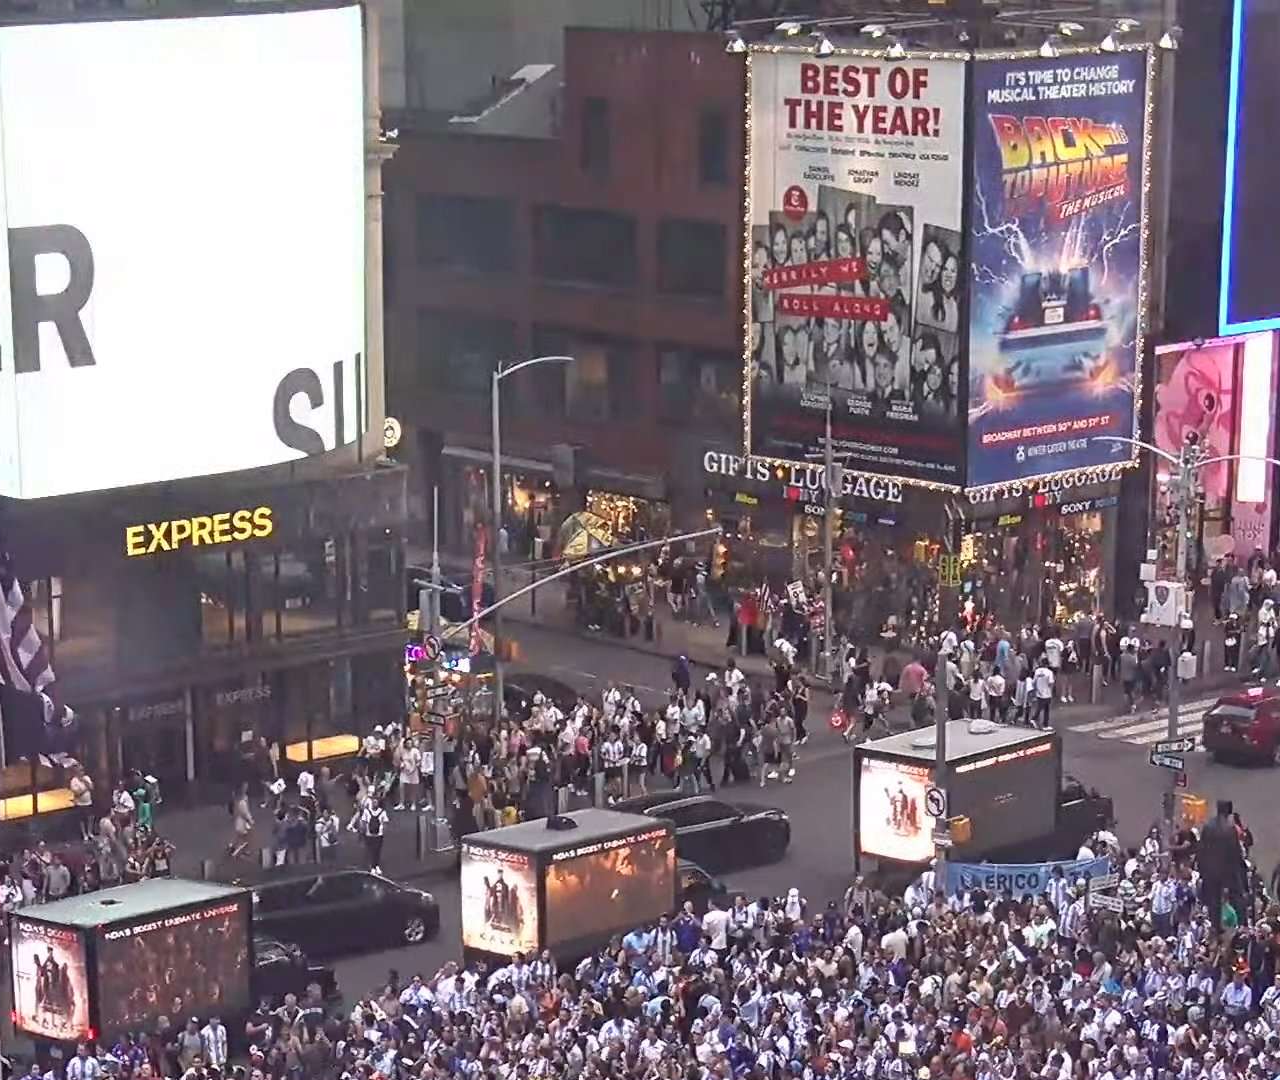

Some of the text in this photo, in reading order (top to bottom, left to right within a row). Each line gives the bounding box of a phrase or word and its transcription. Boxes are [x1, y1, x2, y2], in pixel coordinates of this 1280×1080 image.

[800, 62, 929, 100] BEST OF
[1006, 64, 1120, 87] IT'S TIME TO CHANGE
[987, 79, 1136, 104] MUSICAL THEATER HISTORY
[784, 98, 941, 138] THE YEAR!
[988, 113, 1105, 170] BACK
[1057, 185, 1125, 218] THE MUSICAL
[783, 299, 882, 315] ROLL ALONG
[703, 451, 770, 481] GIFTS
[1060, 500, 1091, 515] SONY
[126, 506, 273, 557] EXPRESS
